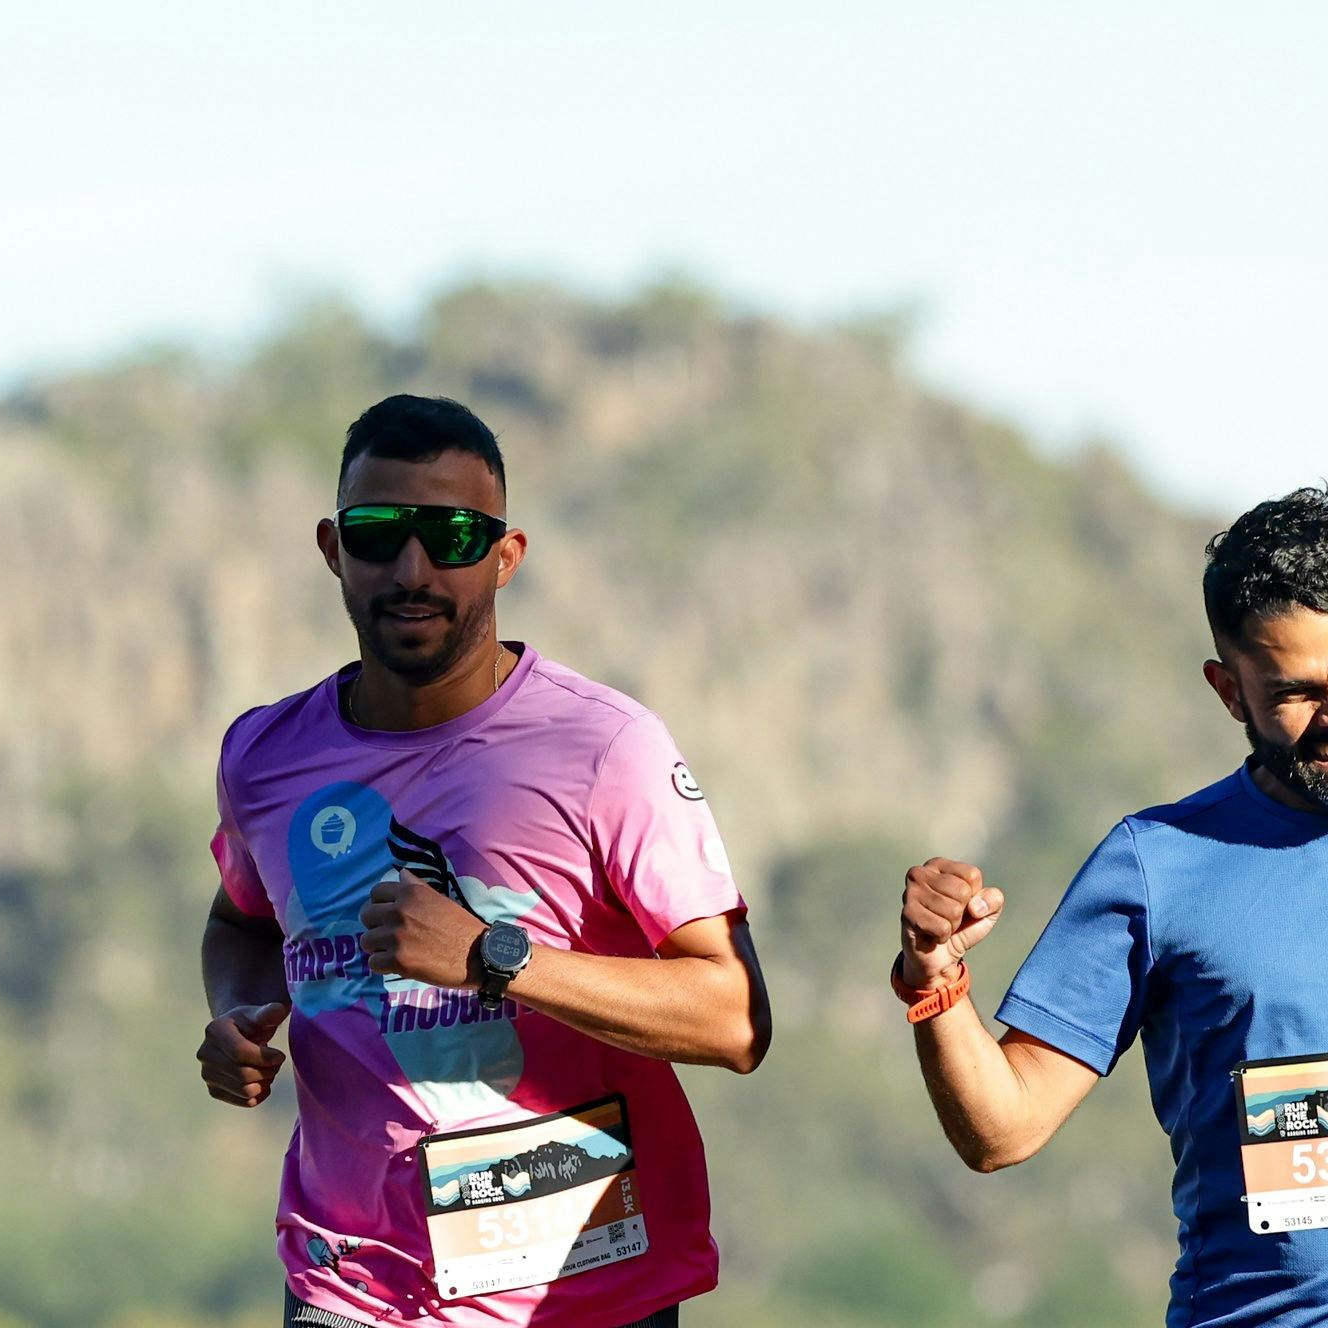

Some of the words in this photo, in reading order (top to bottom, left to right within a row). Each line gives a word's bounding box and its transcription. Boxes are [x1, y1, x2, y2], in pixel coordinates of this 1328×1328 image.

[1284, 1102, 1308, 1113] RUN
[1285, 1111, 1307, 1121] THE
[1286, 1119, 1318, 1131] ROCK
[468, 1170, 493, 1183] RUN
[470, 1180, 493, 1191] THE
[471, 1186, 504, 1199] ROCK
[621, 1177, 634, 1214] 13.5K
[1285, 1216, 1313, 1227] 53145
[616, 1241, 642, 1257] 53147
